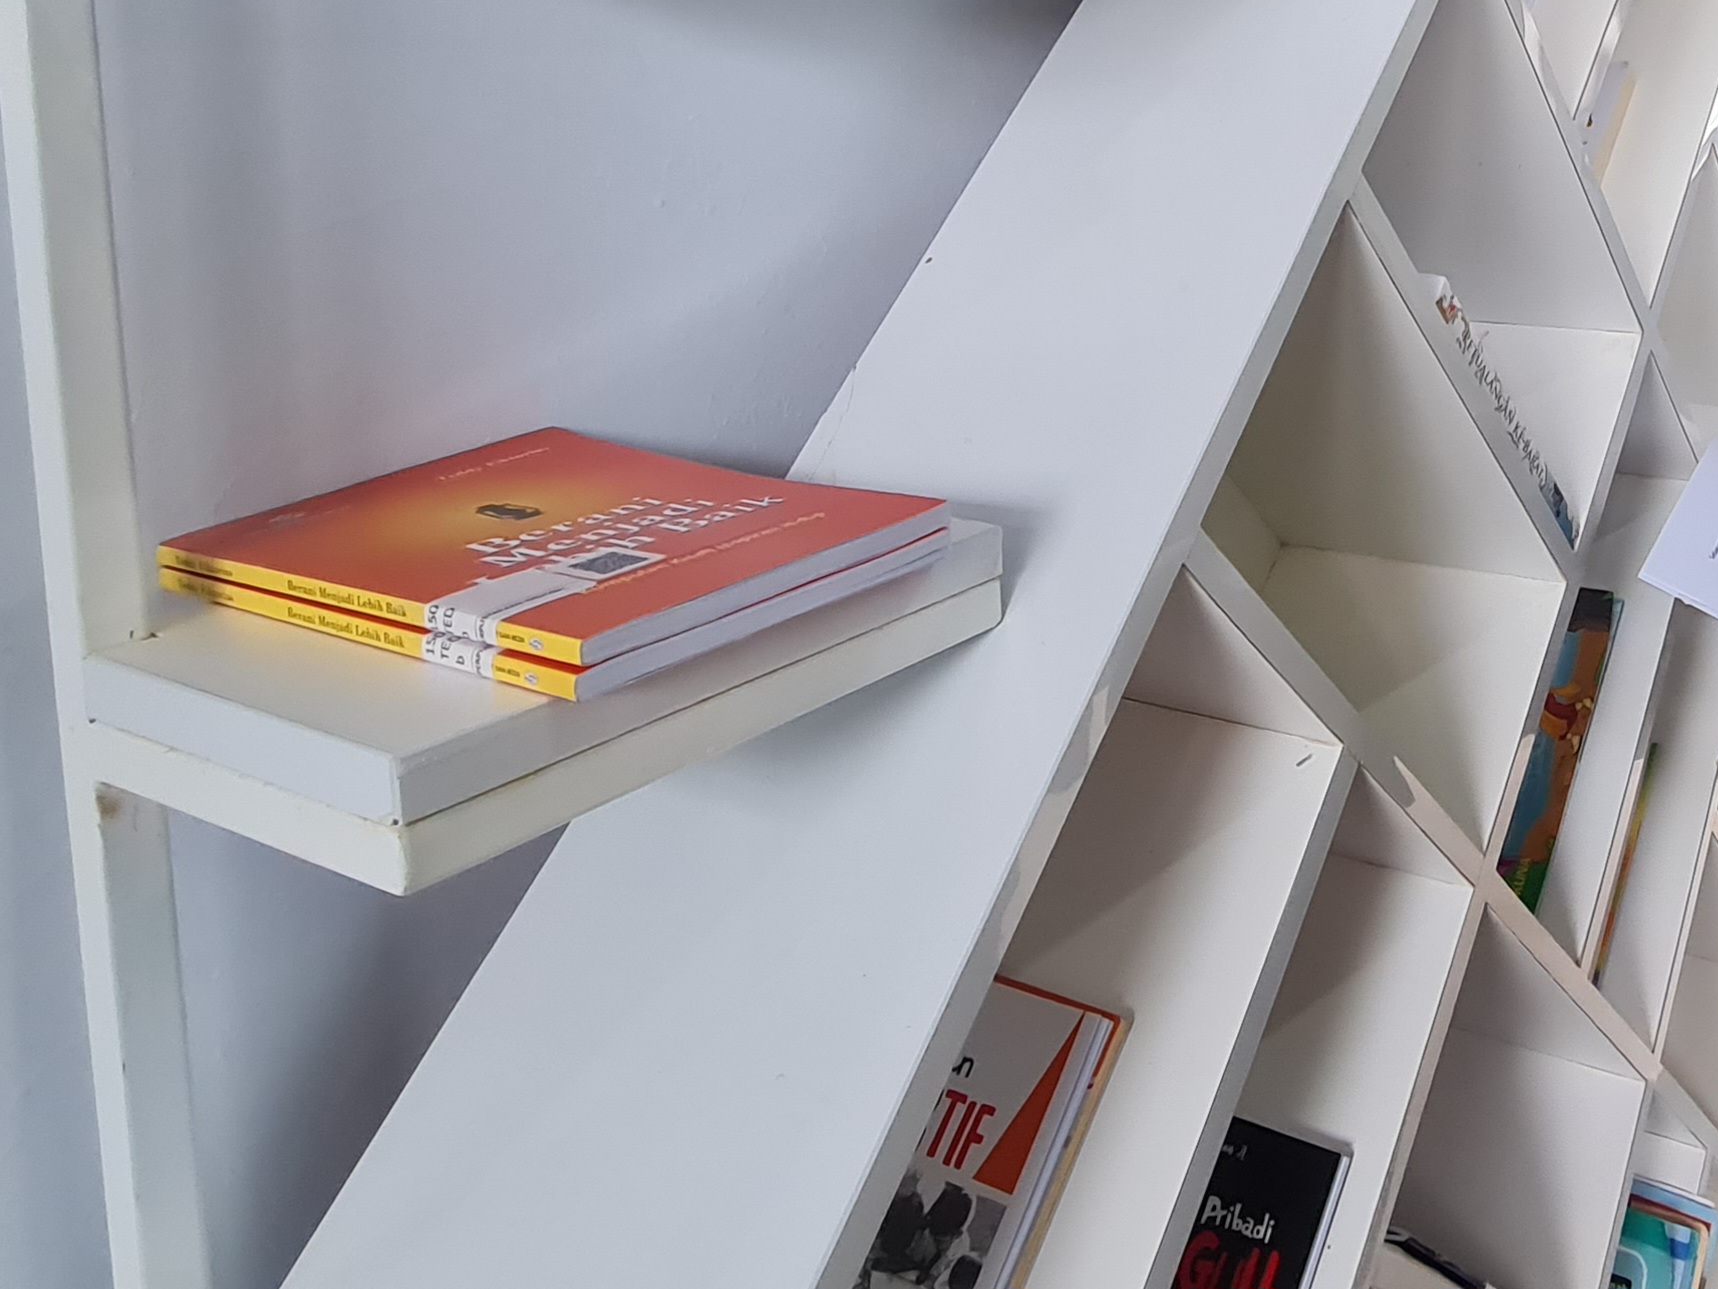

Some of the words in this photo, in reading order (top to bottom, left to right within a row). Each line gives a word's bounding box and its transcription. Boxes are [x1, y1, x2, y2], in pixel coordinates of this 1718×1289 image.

[465, 496, 663, 554] Berani
[480, 498, 716, 569] Menjadi
[655, 495, 784, 534] Baik
[922, 1088, 997, 1171] TIF
[1200, 1194, 1276, 1245] Pribadi
